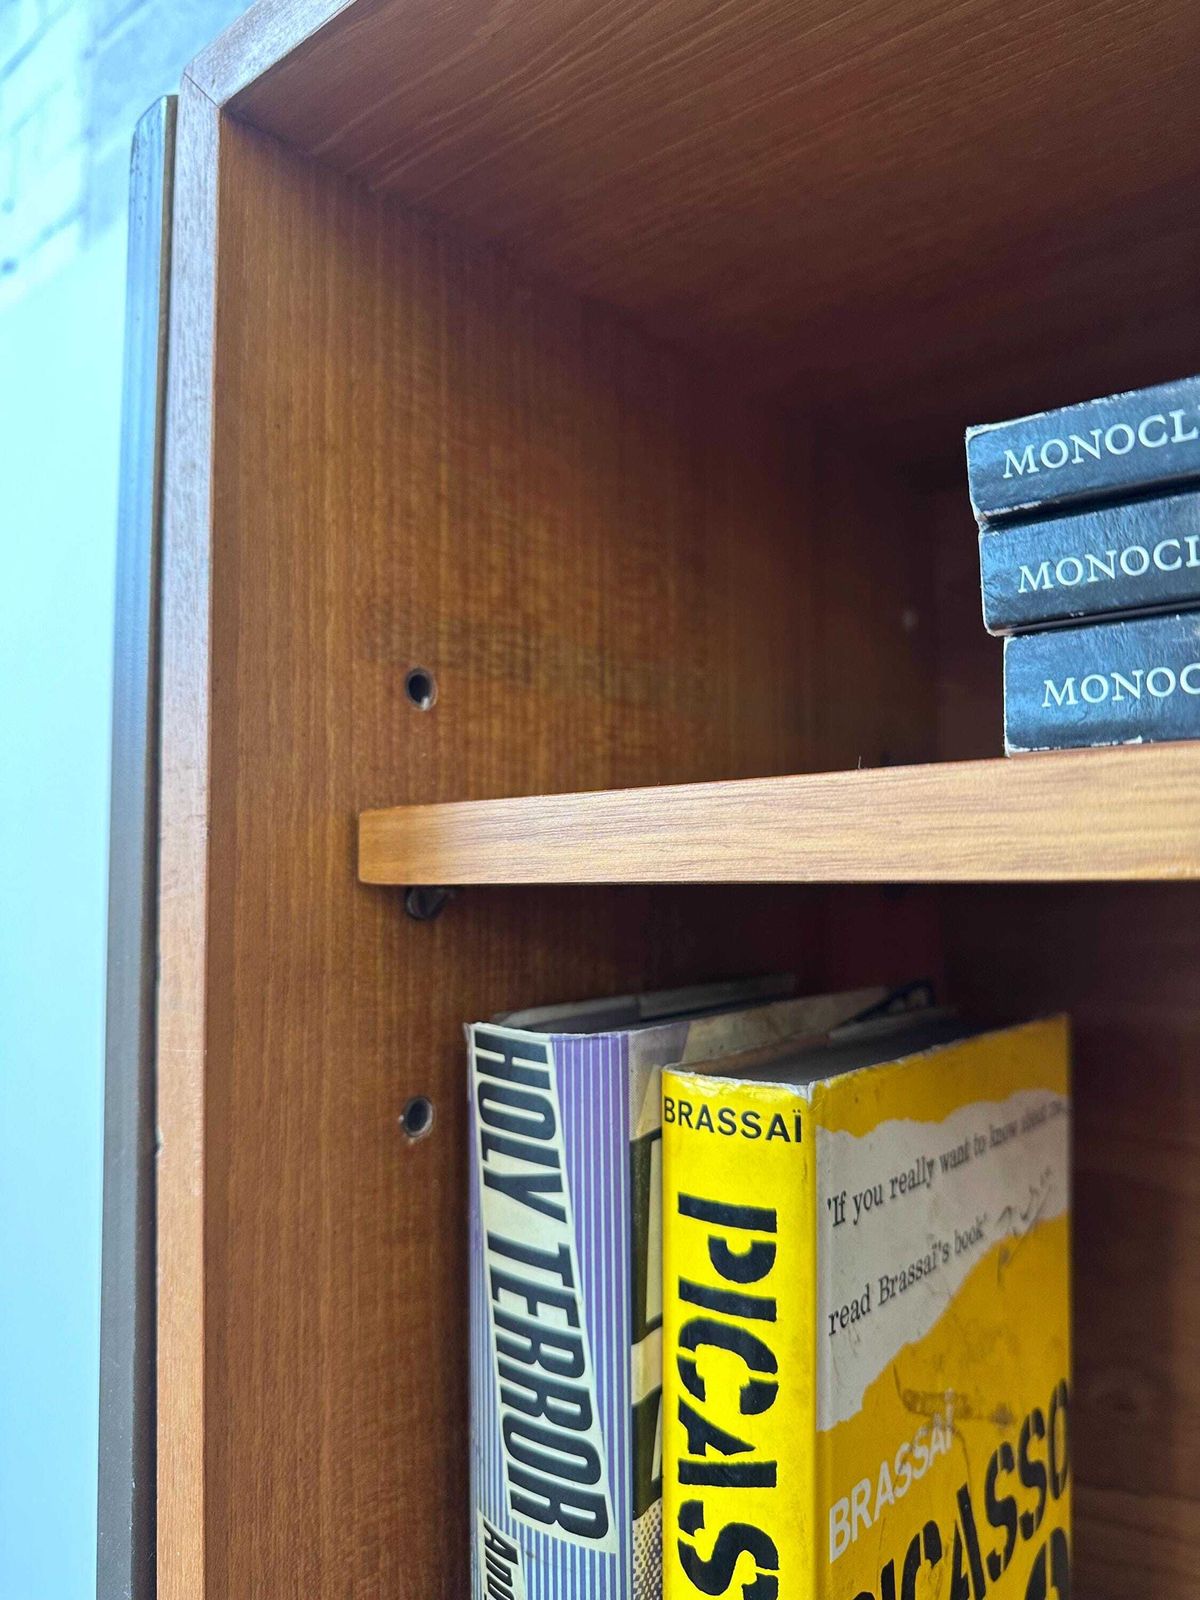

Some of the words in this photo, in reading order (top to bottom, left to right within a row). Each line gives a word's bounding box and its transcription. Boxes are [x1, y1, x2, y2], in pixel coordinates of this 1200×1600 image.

[1002, 405, 1200, 479] MONOCL
[475, 1030, 567, 1224] HOLY
[664, 1096, 802, 1143] BRASSAÏ
[852, 1184, 883, 1225] you
[889, 1156, 935, 1199] really
[939, 1137, 970, 1173] want
[974, 1132, 987, 1156] to
[828, 1283, 871, 1336] read
[487, 1230, 609, 1540] TERROR
[677, 1191, 780, 1600] PICAS
